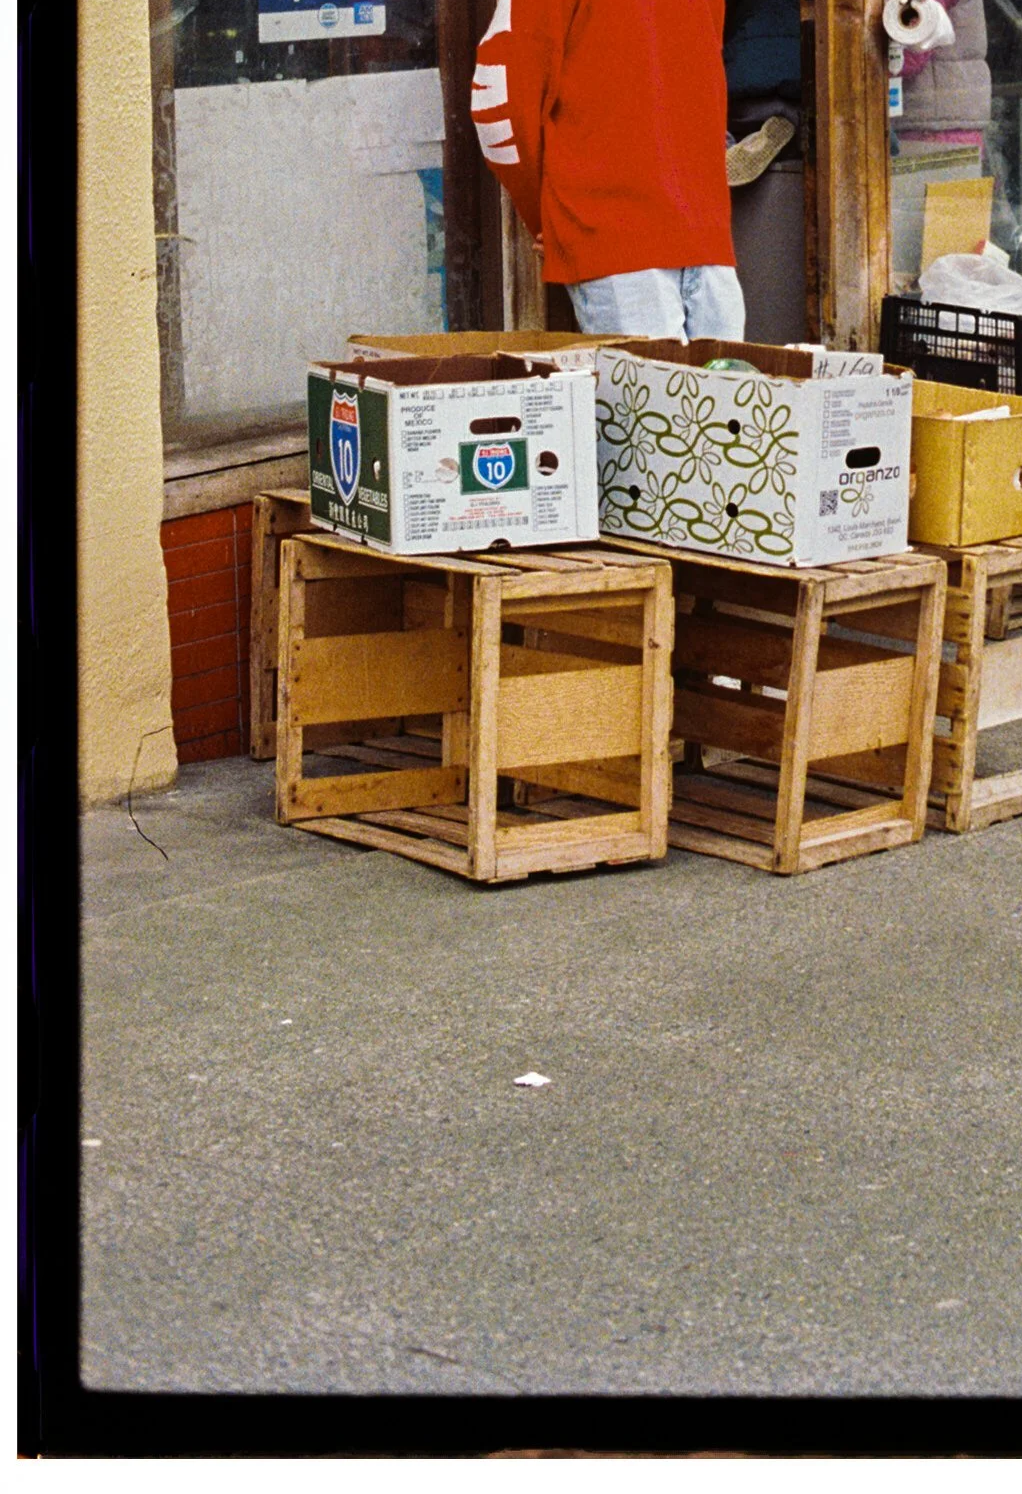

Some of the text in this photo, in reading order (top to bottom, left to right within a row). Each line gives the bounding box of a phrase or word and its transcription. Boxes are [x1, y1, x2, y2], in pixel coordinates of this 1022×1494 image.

[401, 405, 435, 414] PRODUCE
[404, 418, 433, 426] MEXICO
[337, 438, 353, 484] 10
[486, 461, 506, 481] 10
[839, 466, 900, 486] organzo
